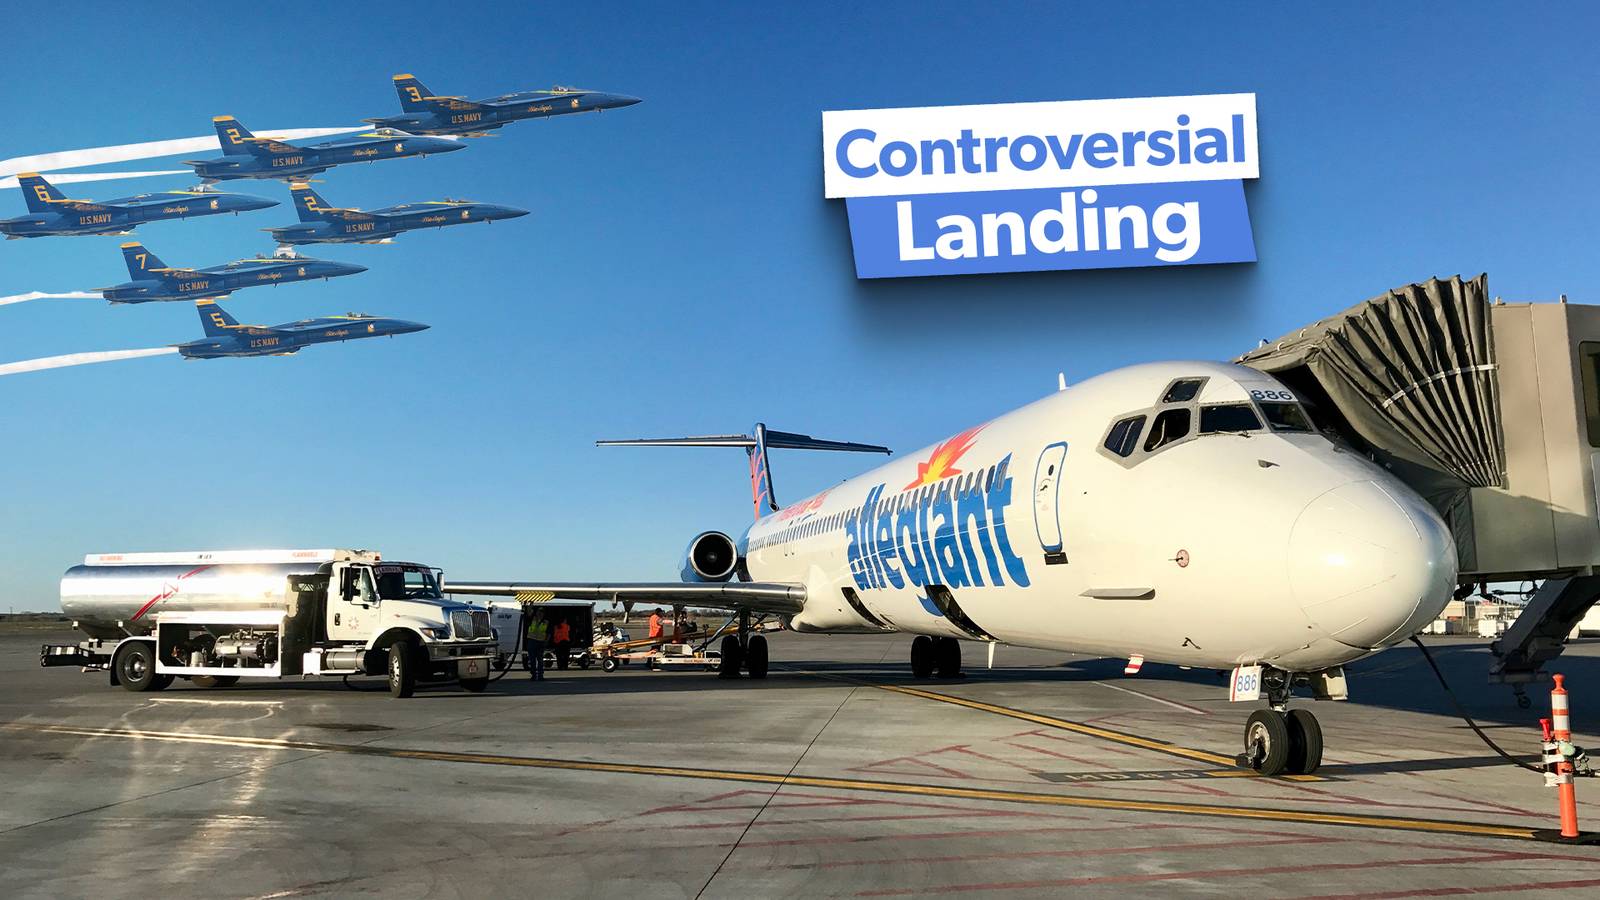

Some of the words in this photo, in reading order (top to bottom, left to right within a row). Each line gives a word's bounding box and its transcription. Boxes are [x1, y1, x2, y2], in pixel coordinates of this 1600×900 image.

[405, 86, 423, 103] 3
[226, 128, 243, 145] 2
[33, 185, 51, 202] 6
[303, 196, 320, 212] 2
[135, 253, 147, 270] 7
[210, 313, 225, 328] 5
[1250, 389, 1293, 400] 886
[847, 452, 1032, 617] allegiant
[1236, 673, 1257, 692] 886
